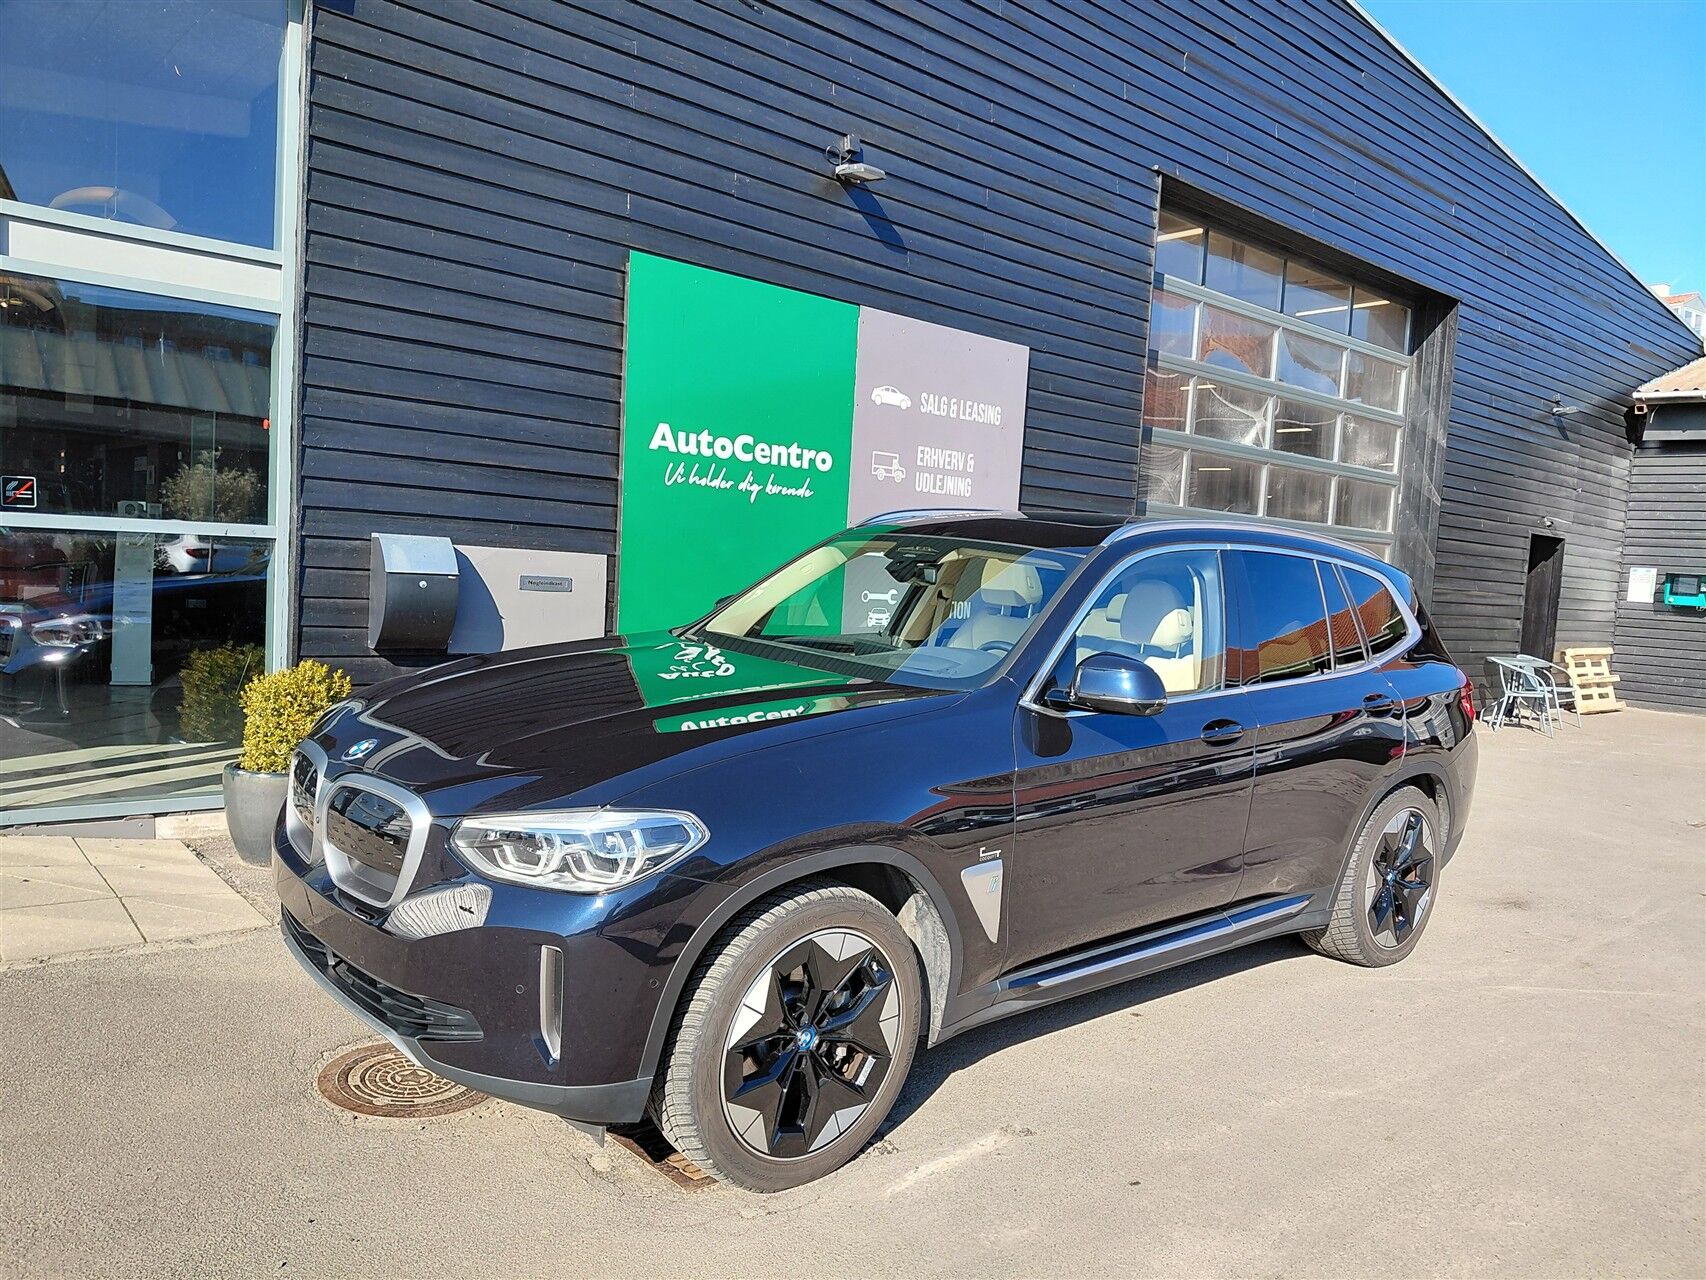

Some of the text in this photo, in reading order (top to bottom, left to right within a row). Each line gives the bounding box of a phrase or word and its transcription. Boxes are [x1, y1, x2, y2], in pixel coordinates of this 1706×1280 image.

[920, 392, 1002, 426] SALG & LEASING
[648, 423, 833, 472] AutoCentro
[916, 445, 975, 473] ERHVERV &
[664, 462, 687, 487] Vi
[688, 463, 735, 490] holder
[737, 470, 764, 504] dig
[914, 471, 972, 498] UDLEJNING
